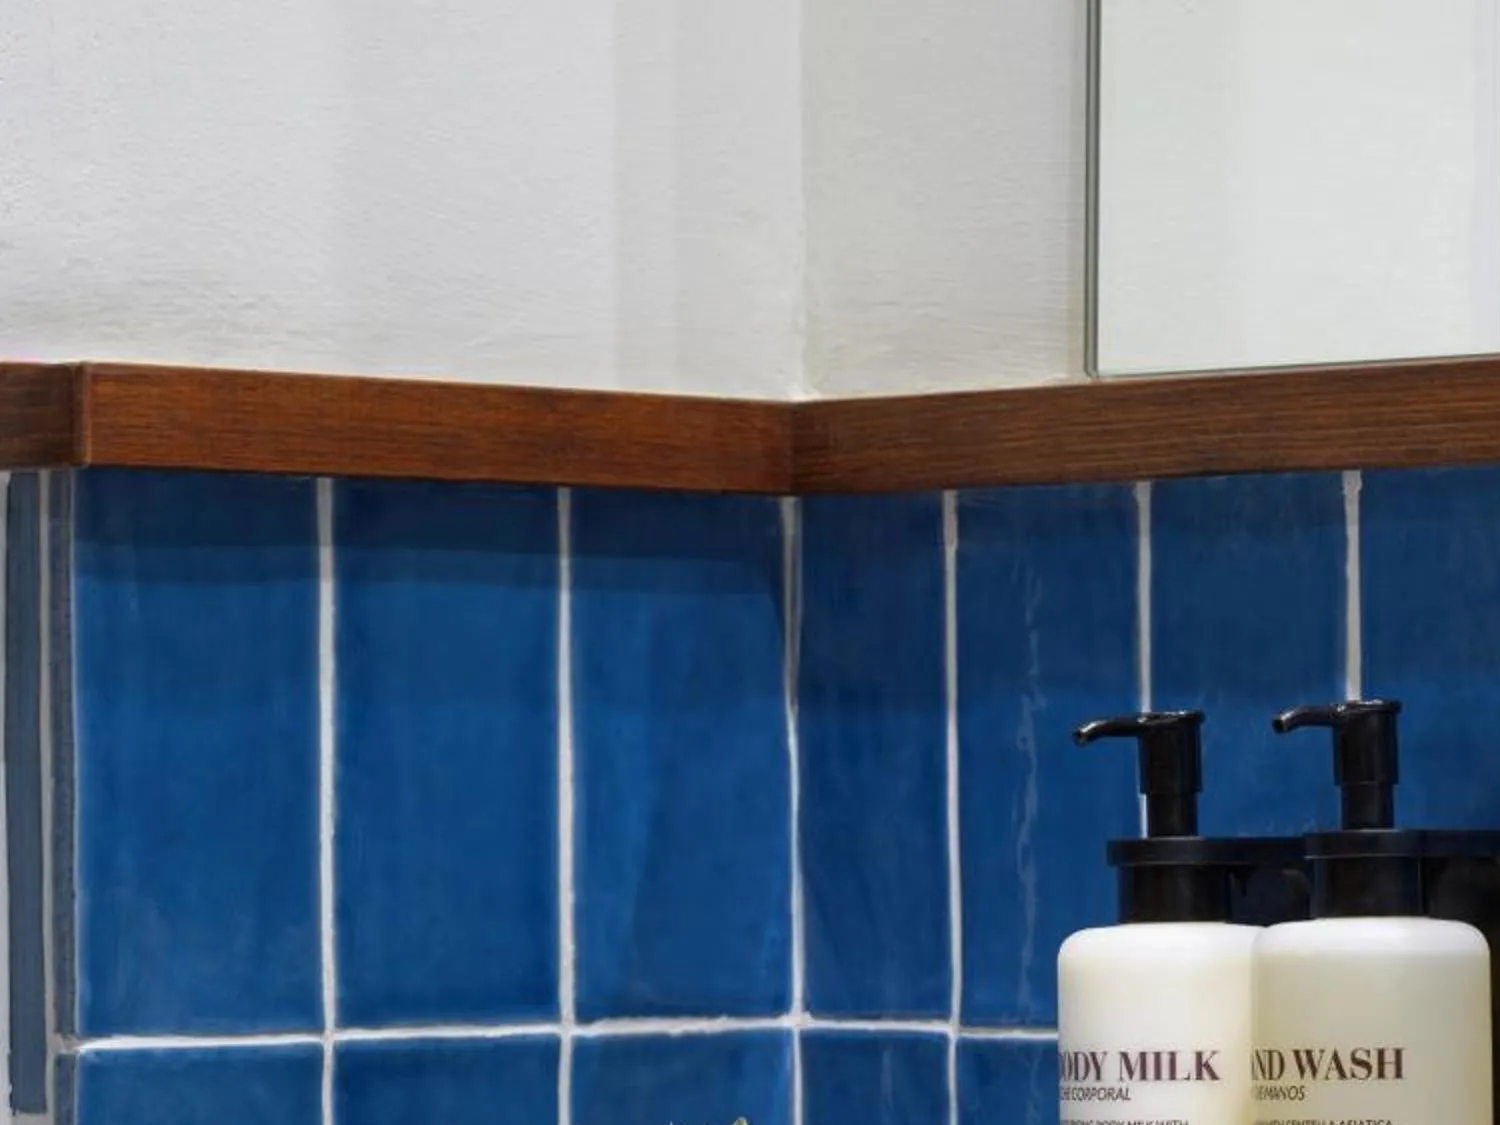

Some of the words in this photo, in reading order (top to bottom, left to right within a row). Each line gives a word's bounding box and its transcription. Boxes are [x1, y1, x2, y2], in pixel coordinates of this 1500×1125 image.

[1061, 1050, 1107, 1081] ODY
[1119, 1050, 1221, 1082] MILK
[1251, 1049, 1286, 1081] ND
[1292, 1048, 1405, 1080] WASH
[1071, 1087, 1132, 1101] CORPORAL
